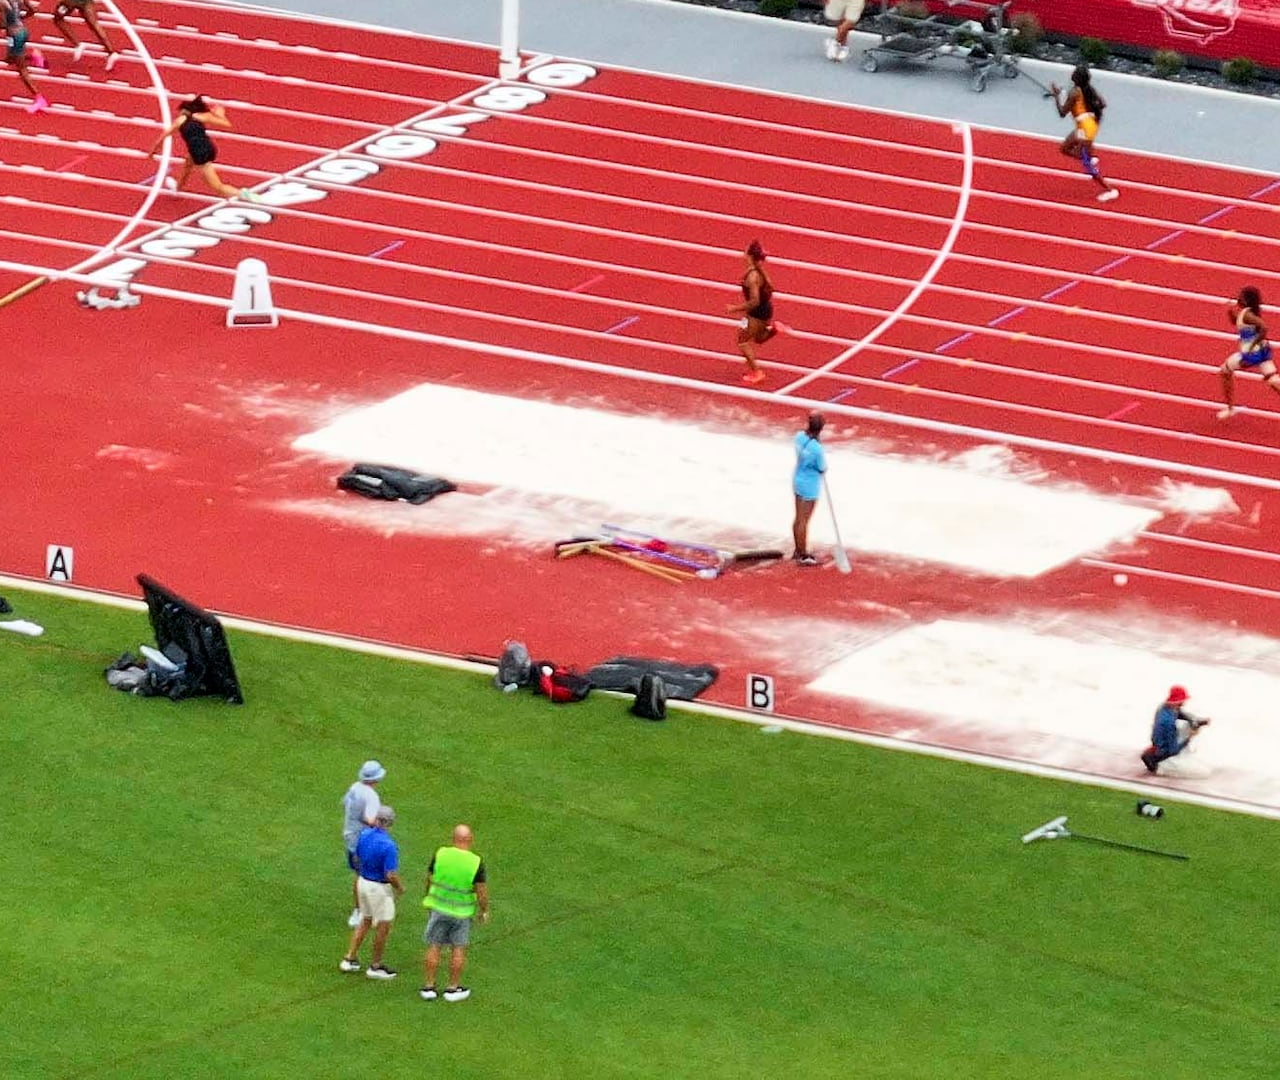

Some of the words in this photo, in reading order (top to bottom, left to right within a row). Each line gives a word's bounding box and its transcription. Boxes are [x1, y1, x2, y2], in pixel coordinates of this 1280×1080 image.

[140, 230, 222, 259] 2
[198, 207, 273, 233] 3
[304, 158, 380, 185] 5
[365, 134, 438, 160] 6
[410, 112, 494, 137] 7
[473, 86, 548, 112] 8
[527, 62, 598, 88] 9
[249, 285, 255, 310] 1
[49, 547, 68, 581] A
[751, 676, 769, 709] B
